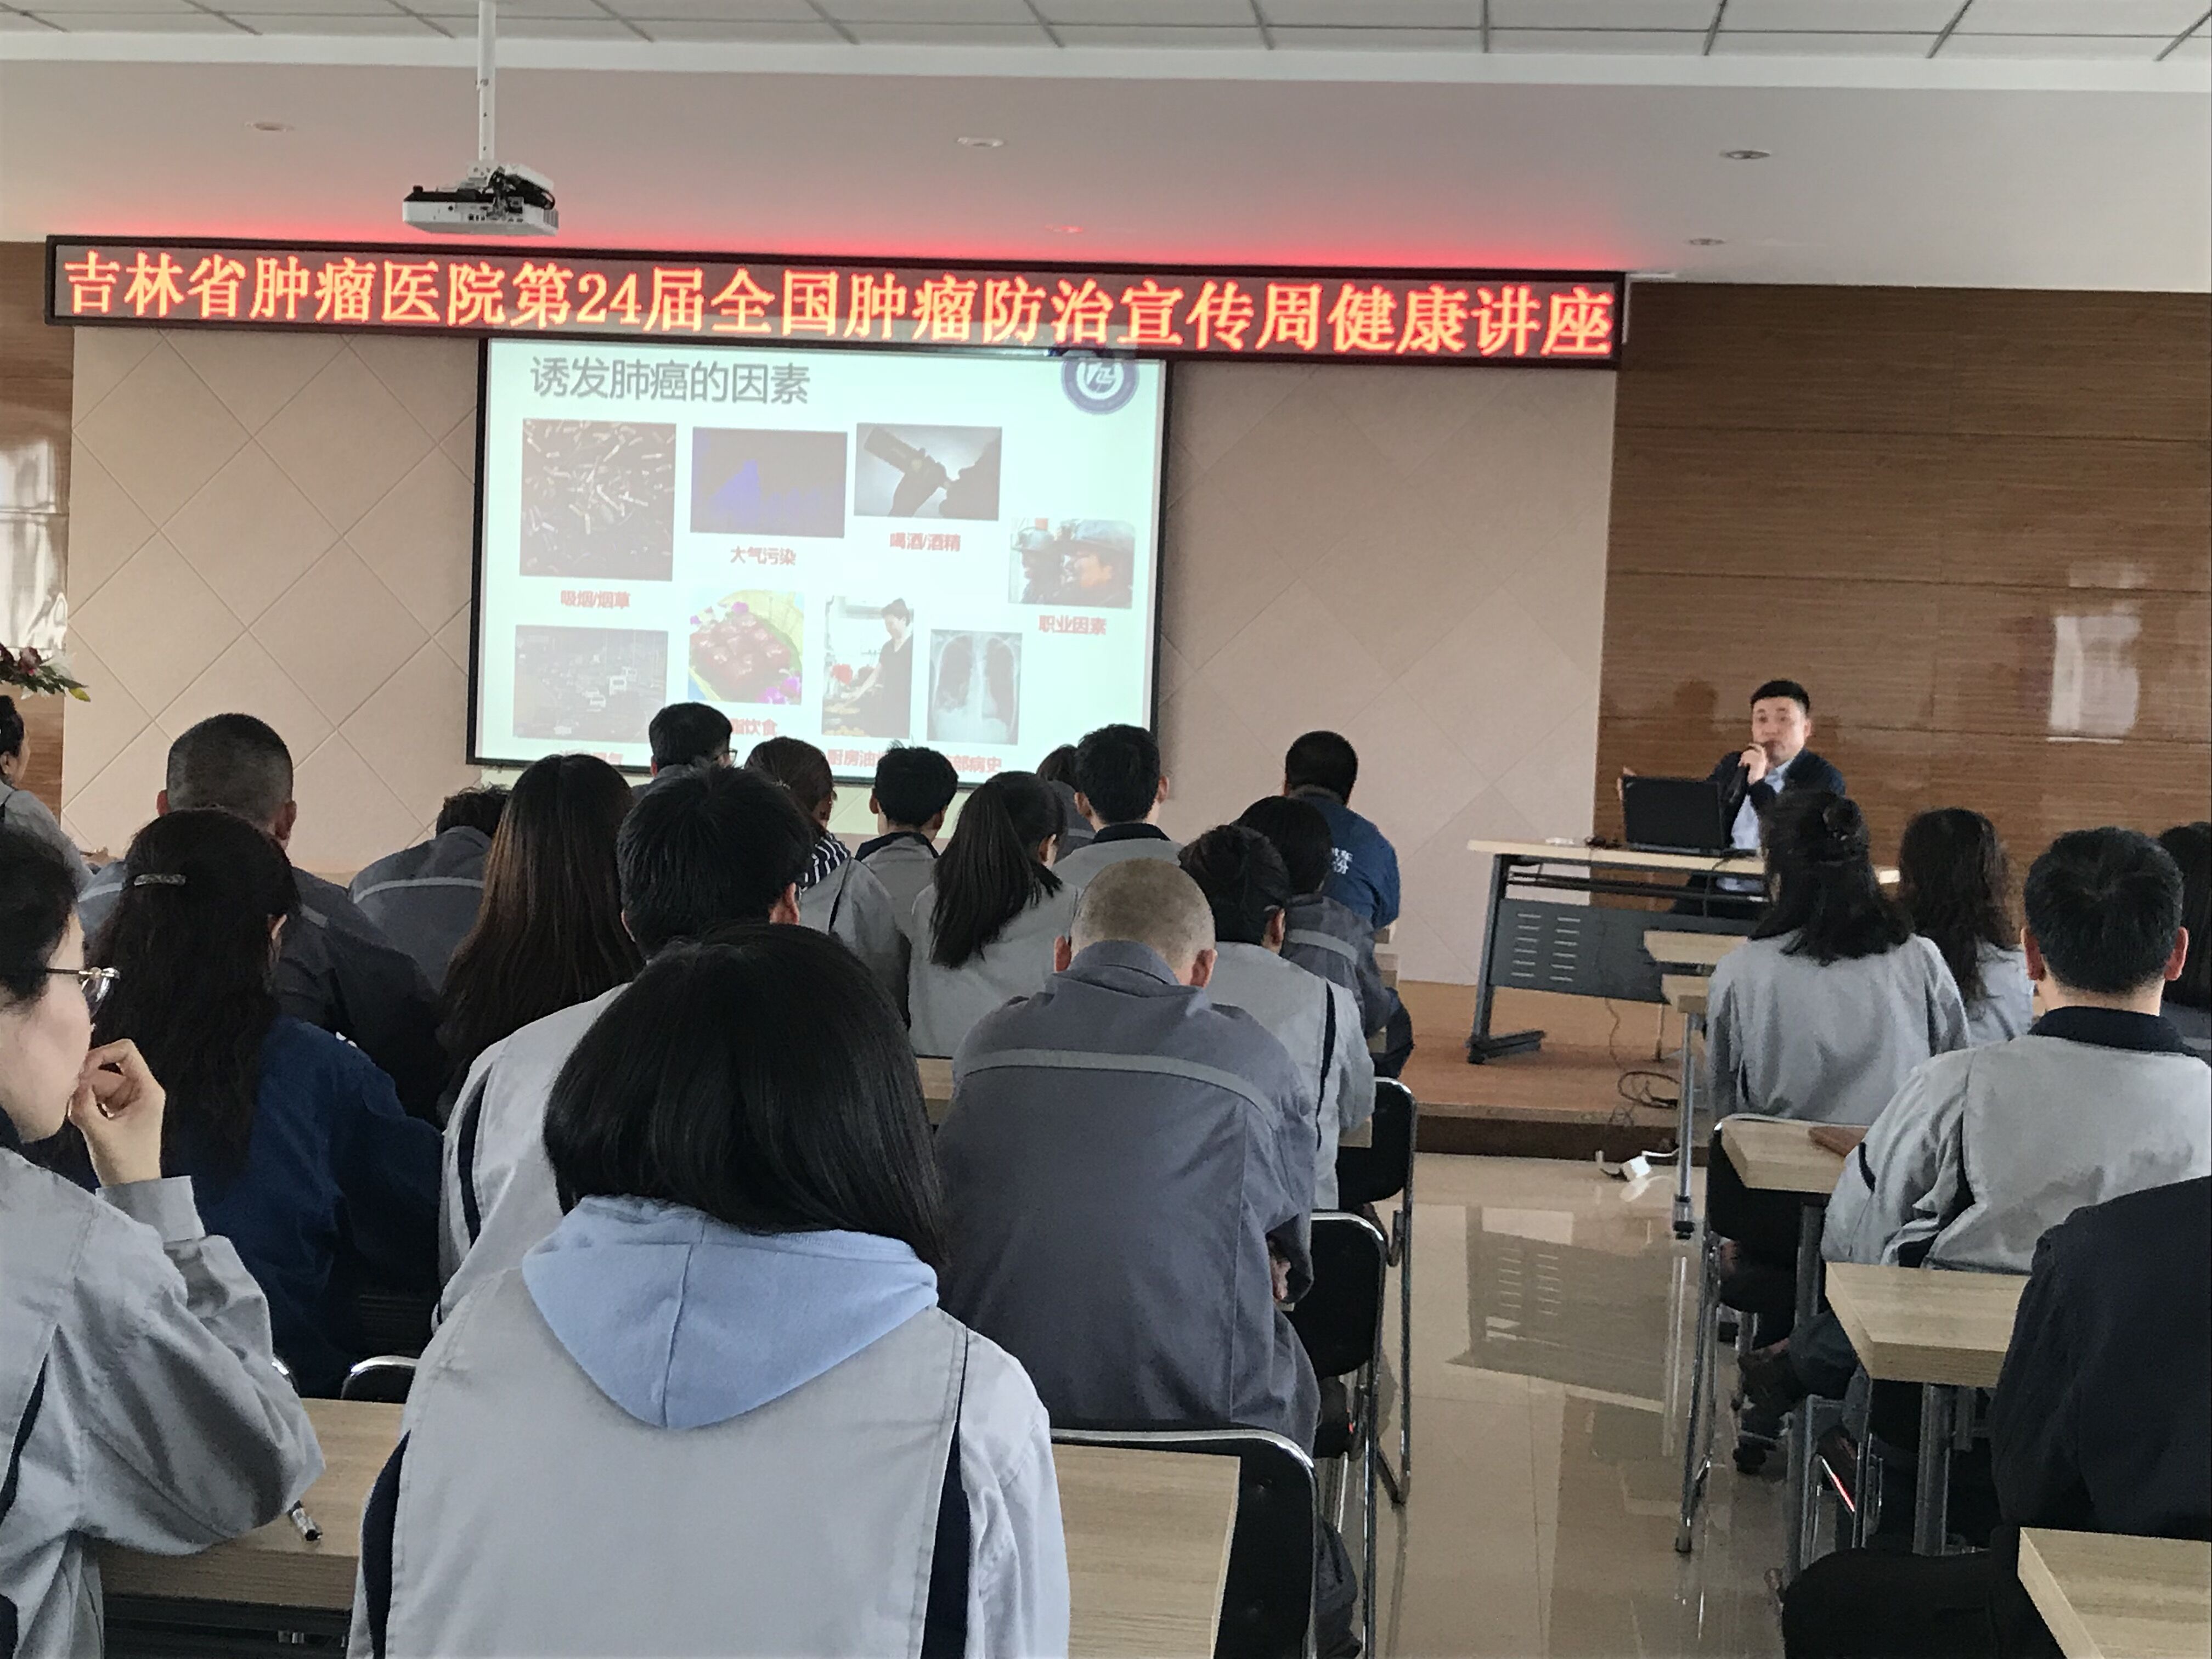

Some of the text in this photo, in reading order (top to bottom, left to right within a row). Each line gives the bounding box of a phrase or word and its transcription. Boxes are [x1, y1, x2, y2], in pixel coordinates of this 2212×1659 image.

[63, 248, 1614, 357] 吉林省肿瘤医院第24届全国肿瘤防治宣传周健康讲座
[530, 356, 810, 404] 诱发肺癌的因素
[890, 532, 961, 551] 喝酒/酒精
[730, 545, 797, 566] 大气污染
[561, 590, 630, 609] 吸烟/烟草
[1039, 614, 1107, 635] 职业因素
